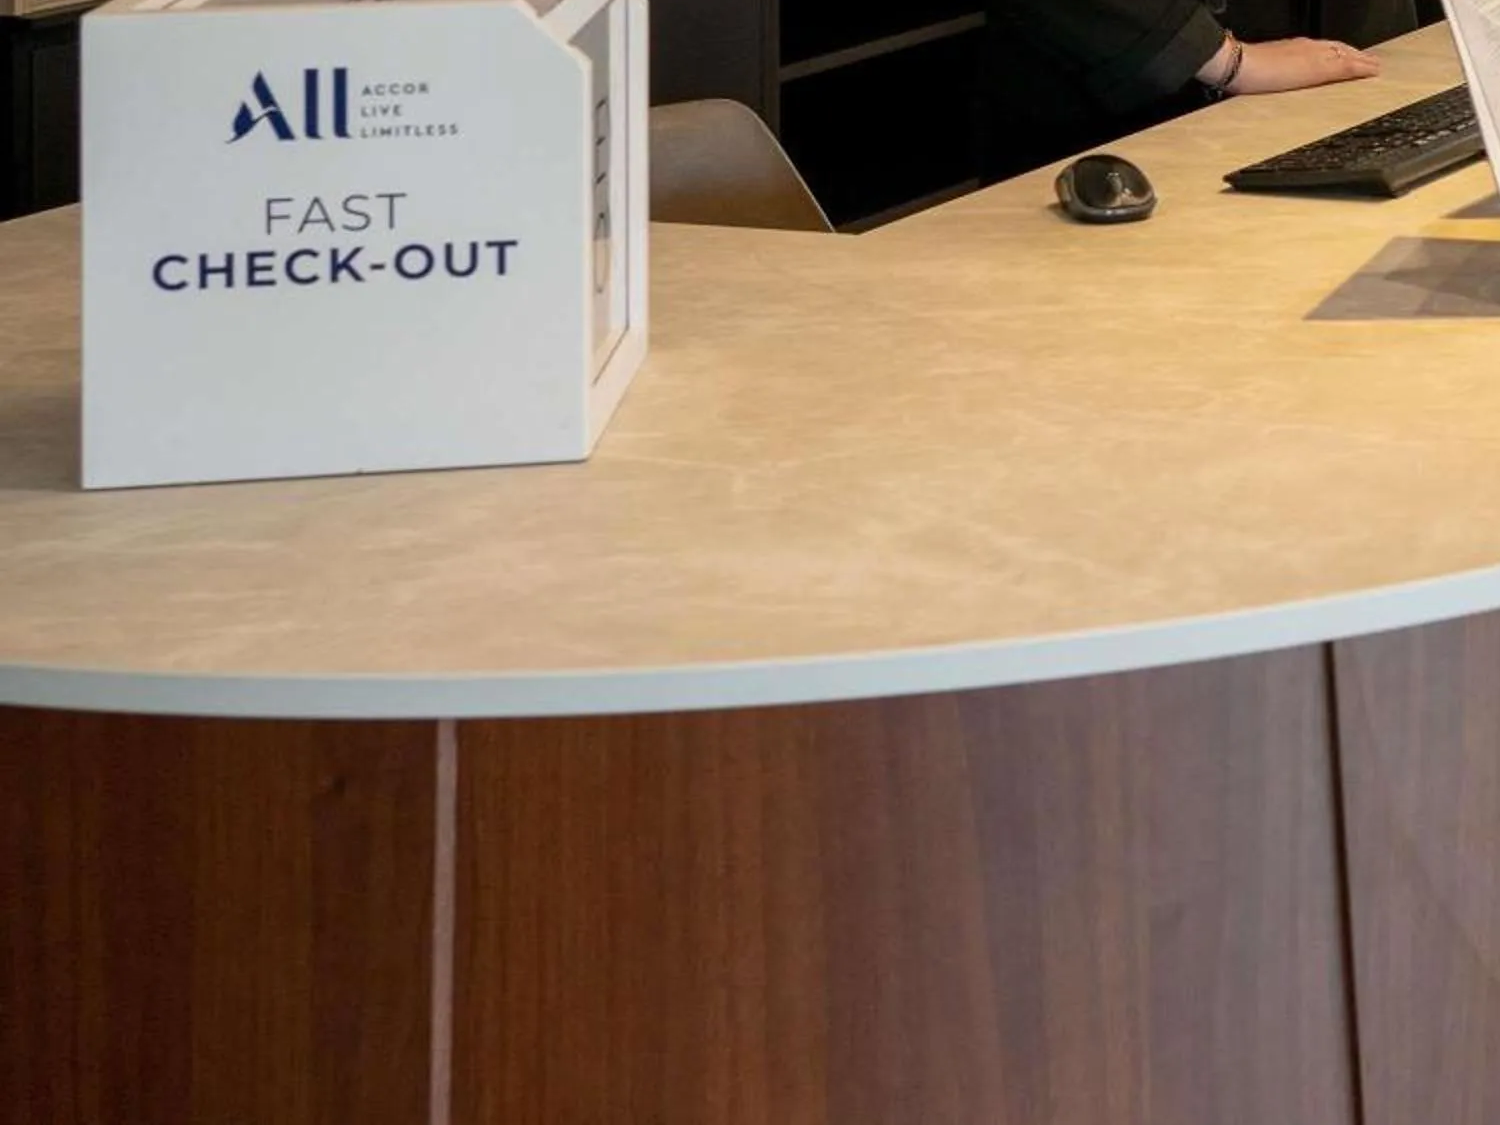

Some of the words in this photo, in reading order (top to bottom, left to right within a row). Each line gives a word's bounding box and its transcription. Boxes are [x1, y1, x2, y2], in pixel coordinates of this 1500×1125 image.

[361, 82, 429, 96] ACCOR
[360, 105, 402, 117] LIVE
[360, 124, 459, 138] LIMITLESS
[265, 193, 407, 235] FAST
[152, 240, 519, 291] CHECK-OUT
